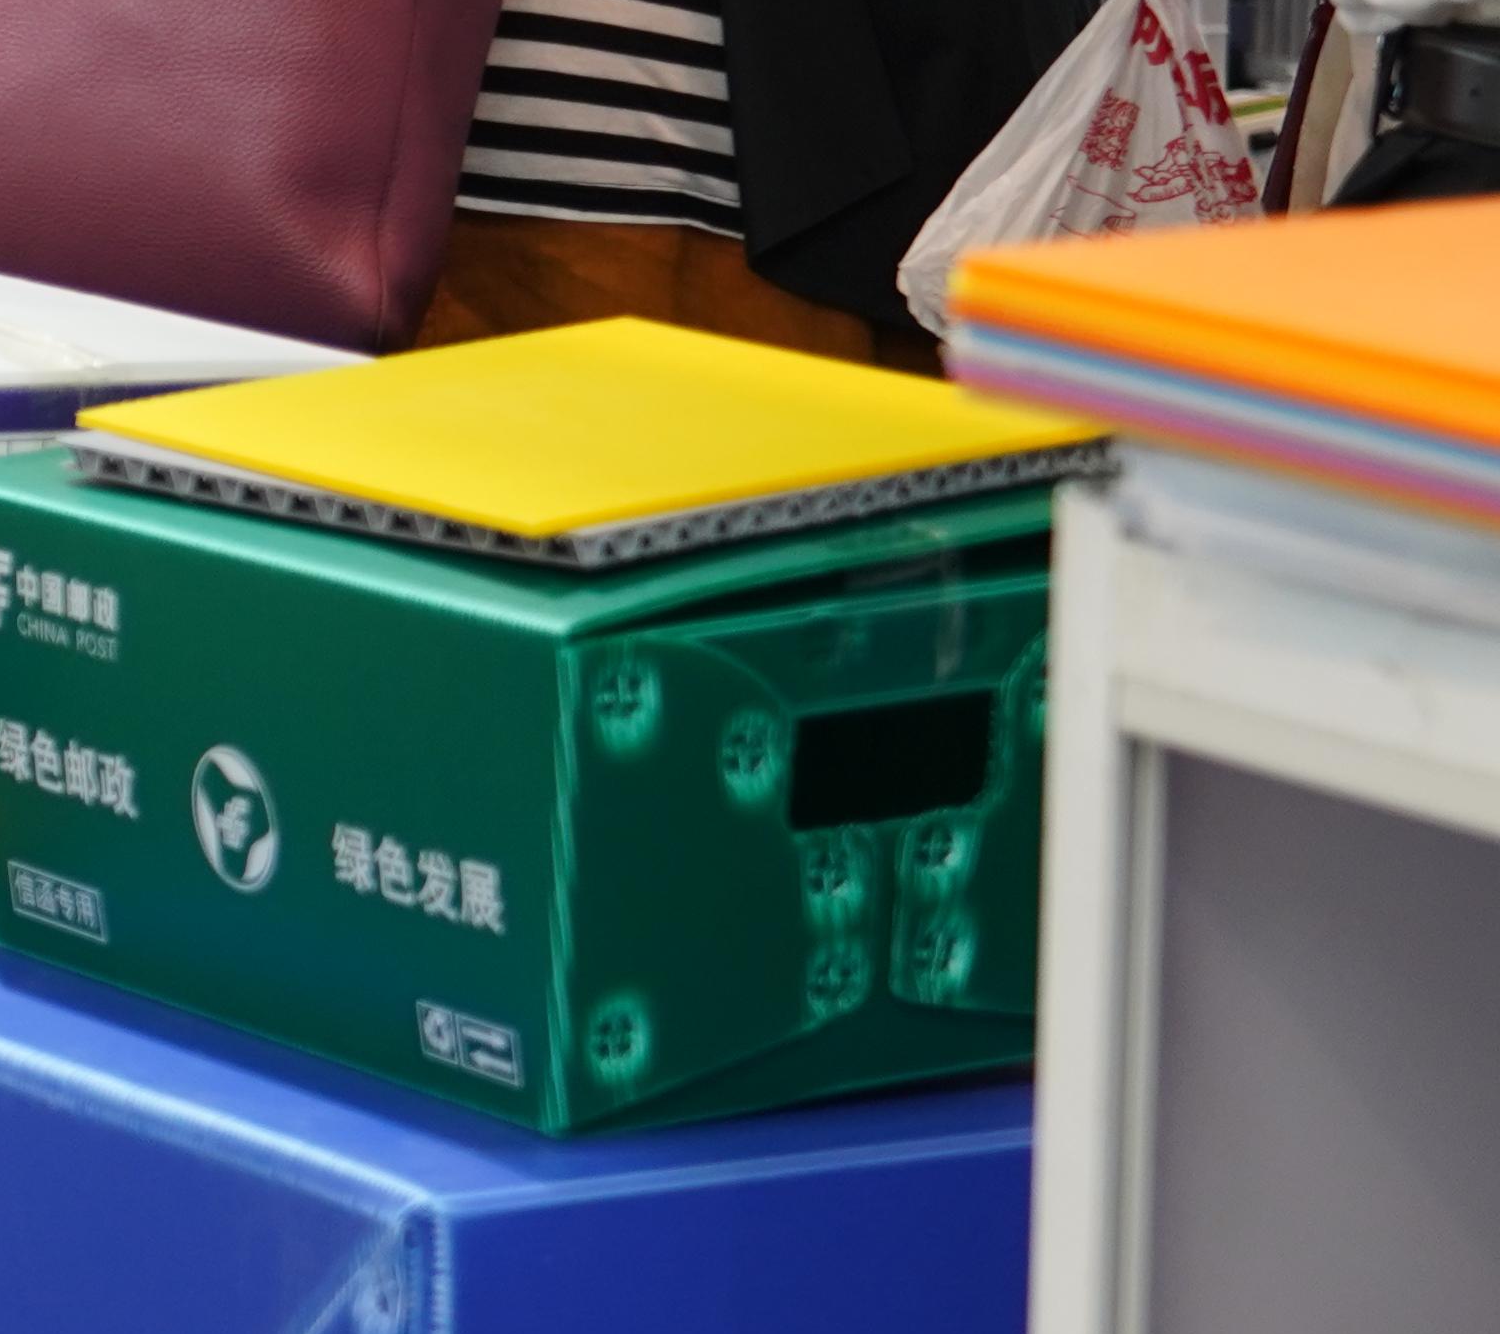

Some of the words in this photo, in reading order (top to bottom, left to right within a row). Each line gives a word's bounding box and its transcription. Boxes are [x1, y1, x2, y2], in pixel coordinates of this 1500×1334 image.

[15, 565, 120, 631] 中国邮政
[16, 612, 70, 650] CHINA
[75, 628, 119, 661] POST
[331, 822, 506, 937] 绿色发展
